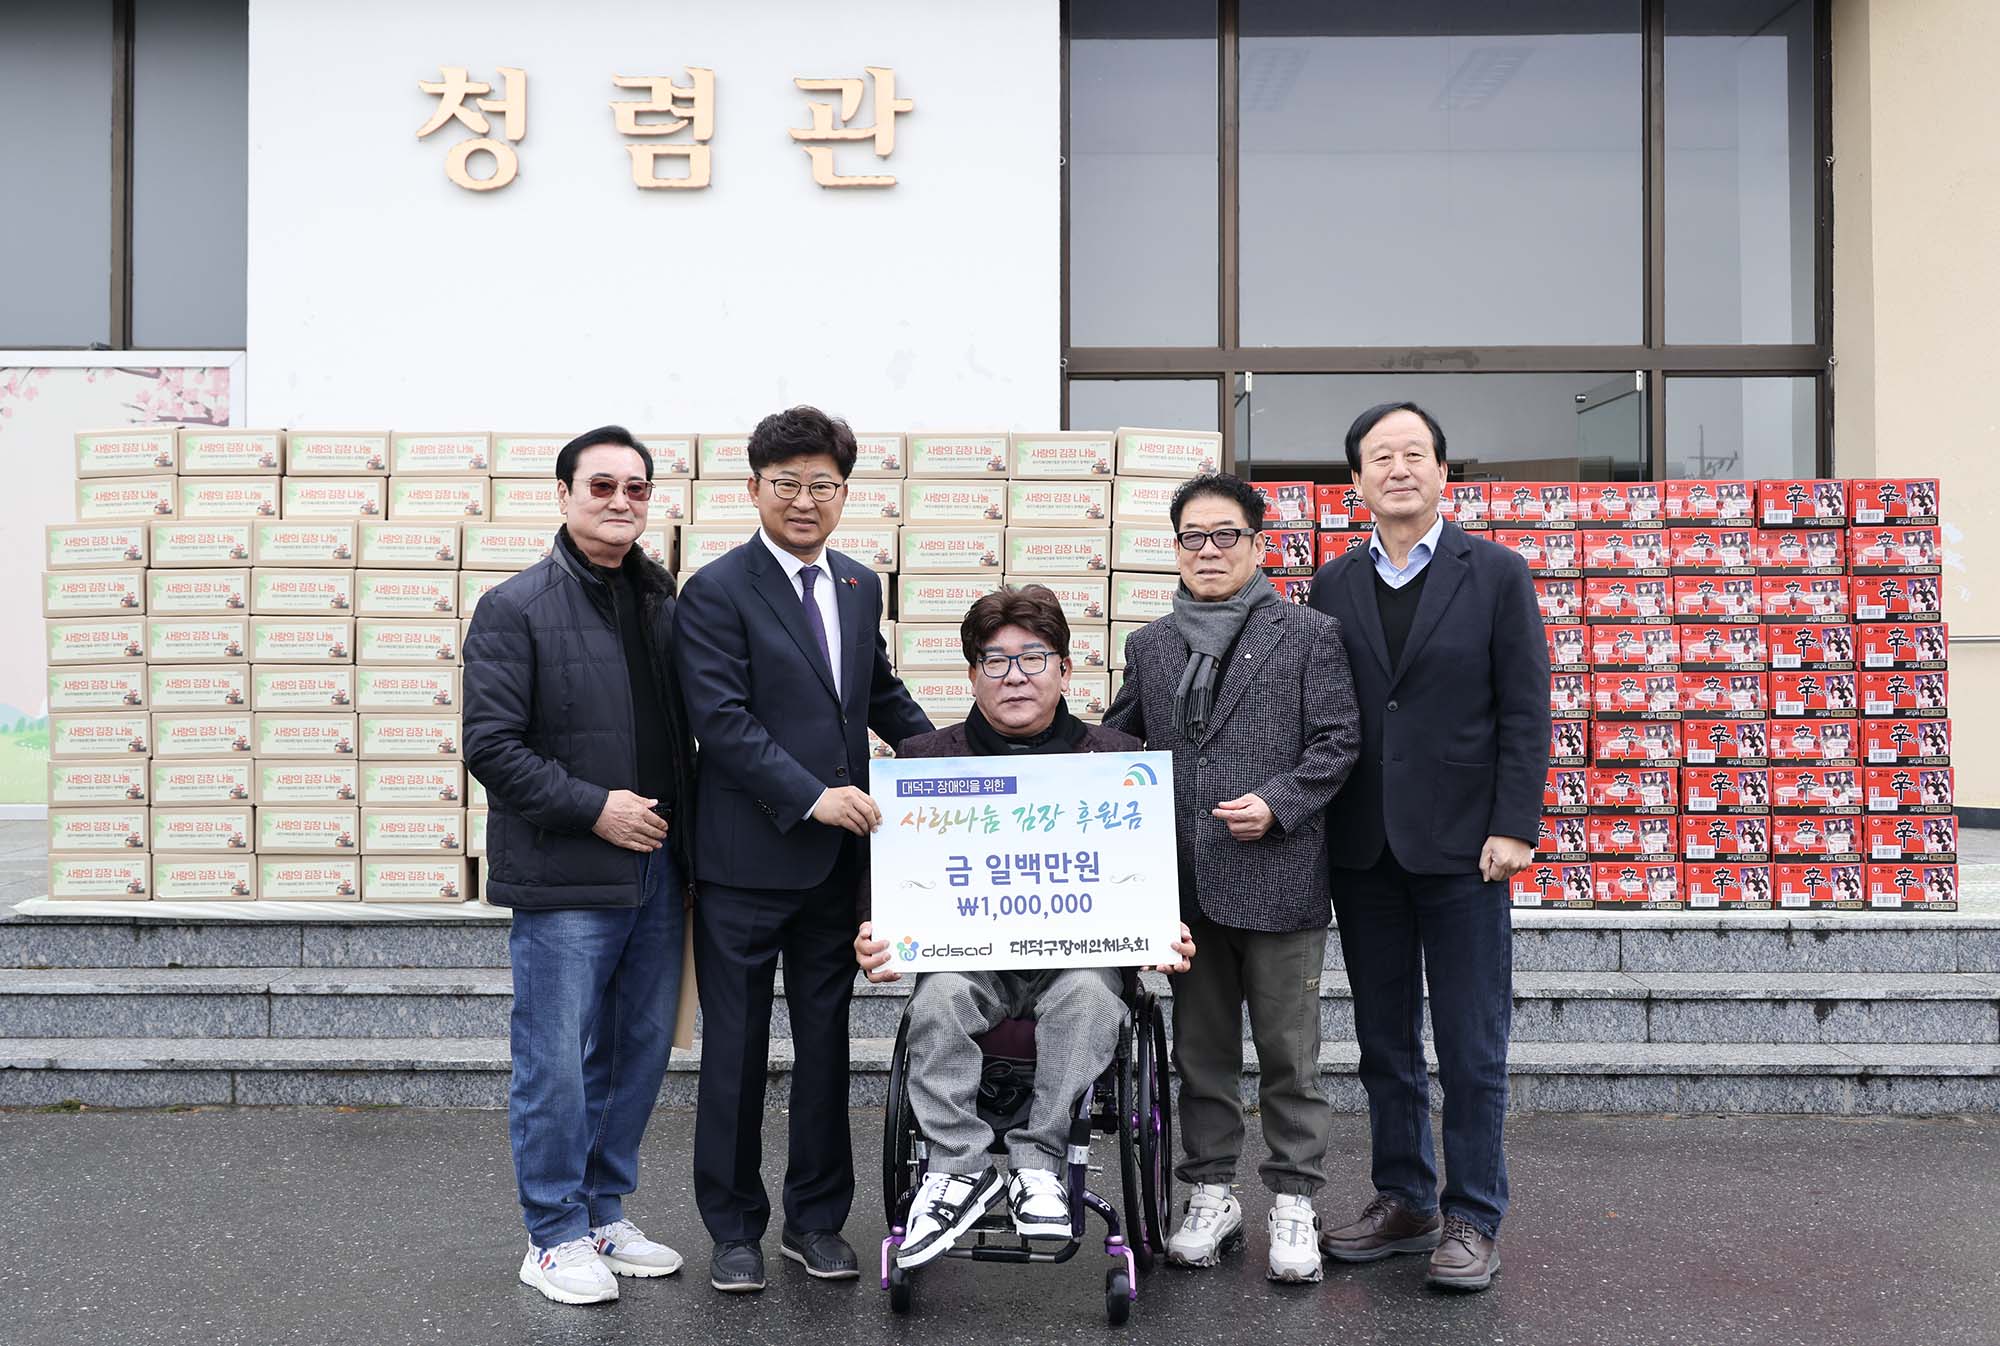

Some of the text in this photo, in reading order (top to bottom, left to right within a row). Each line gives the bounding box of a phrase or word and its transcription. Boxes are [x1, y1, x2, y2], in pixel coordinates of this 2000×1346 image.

[93, 442, 159, 454] 사랑의 김장 나눔
[305, 444, 371, 455] 사랑의 김장 나눔
[926, 446, 992, 456] 사랑의 김장 나눔
[1030, 448, 1097, 459] 사랑의 김장 나눔
[1138, 444, 1204, 456] 사랑의 김장 나눔
[93, 490, 159, 502] 사랑의 김장 나눔
[197, 490, 262, 501] 사랑의 김장 나눔
[299, 490, 365, 500] 사랑의 김장 나눔
[406, 490, 470, 501] 사랑의 김장 나눔
[923, 492, 989, 504] 사랑의 김장 나눔
[1025, 492, 1091, 504] 사랑의 김장 나눔
[1786, 483, 1809, 513] 辛
[1878, 483, 1901, 513] 辛
[1342, 488, 1365, 518] 辛
[272, 534, 338, 544] 사랑의 김장 나눔
[918, 540, 985, 551] 사랑의 김장 나눔
[1025, 544, 1092, 555] 사랑의 김장 나눔
[60, 582, 125, 593] 사랑의 김장 나눔
[165, 582, 231, 594] 사랑의 김장 나눔
[270, 582, 336, 593] 사랑의 김장 나눔
[373, 584, 439, 596] 사랑의 김장 나눔
[1880, 579, 1902, 609] 辛
[63, 632, 129, 643] 사랑의 김장 나눔
[268, 632, 334, 642] 사랑의 김장 나눔
[1794, 628, 1817, 658] 辛
[1888, 627, 1910, 657] 辛
[62, 680, 128, 691] 사랑의 김장 나눔
[164, 678, 230, 689] 사랑의 김장 나눔
[372, 678, 438, 690] 사랑의 김장 나눔
[1798, 675, 1820, 705] 辛
[1888, 675, 1910, 705] 辛
[67, 726, 133, 737] 사랑의 김장 나눔
[170, 726, 236, 737] 사랑의 김장 나눔
[377, 728, 443, 738] 사랑의 김장 나눔
[1710, 723, 1732, 753] 辛
[1890, 723, 1913, 753] 辛
[378, 774, 444, 785] 사랑의 김장 나눔
[902, 778, 1005, 794] 대덕구 장애인을 위한
[1710, 771, 1733, 801] 辛
[1796, 772, 1819, 802] 辛
[1892, 771, 1914, 801] 辛
[900, 800, 1144, 834] 사랑나눔 김장 후원금
[275, 820, 341, 832] 사랑의 김장 나눔
[379, 822, 445, 833] 사랑의 김장 나눔
[1708, 819, 1731, 849] 辛
[1896, 819, 1918, 849] 辛
[66, 868, 132, 879] 사랑의 김장 나눔
[945, 850, 1101, 887] 금 일백만원
[169, 870, 236, 881] 사랑의 김장 나눔
[1536, 866, 1558, 896] 辛
[1712, 867, 1735, 897] 辛
[1804, 867, 1826, 897] 辛
[1896, 867, 1918, 897] 辛
[956, 893, 1093, 920] ₩1,000,000
[921, 943, 993, 957] ddsad
[1010, 937, 1149, 956] 대덕구장애인체육회
